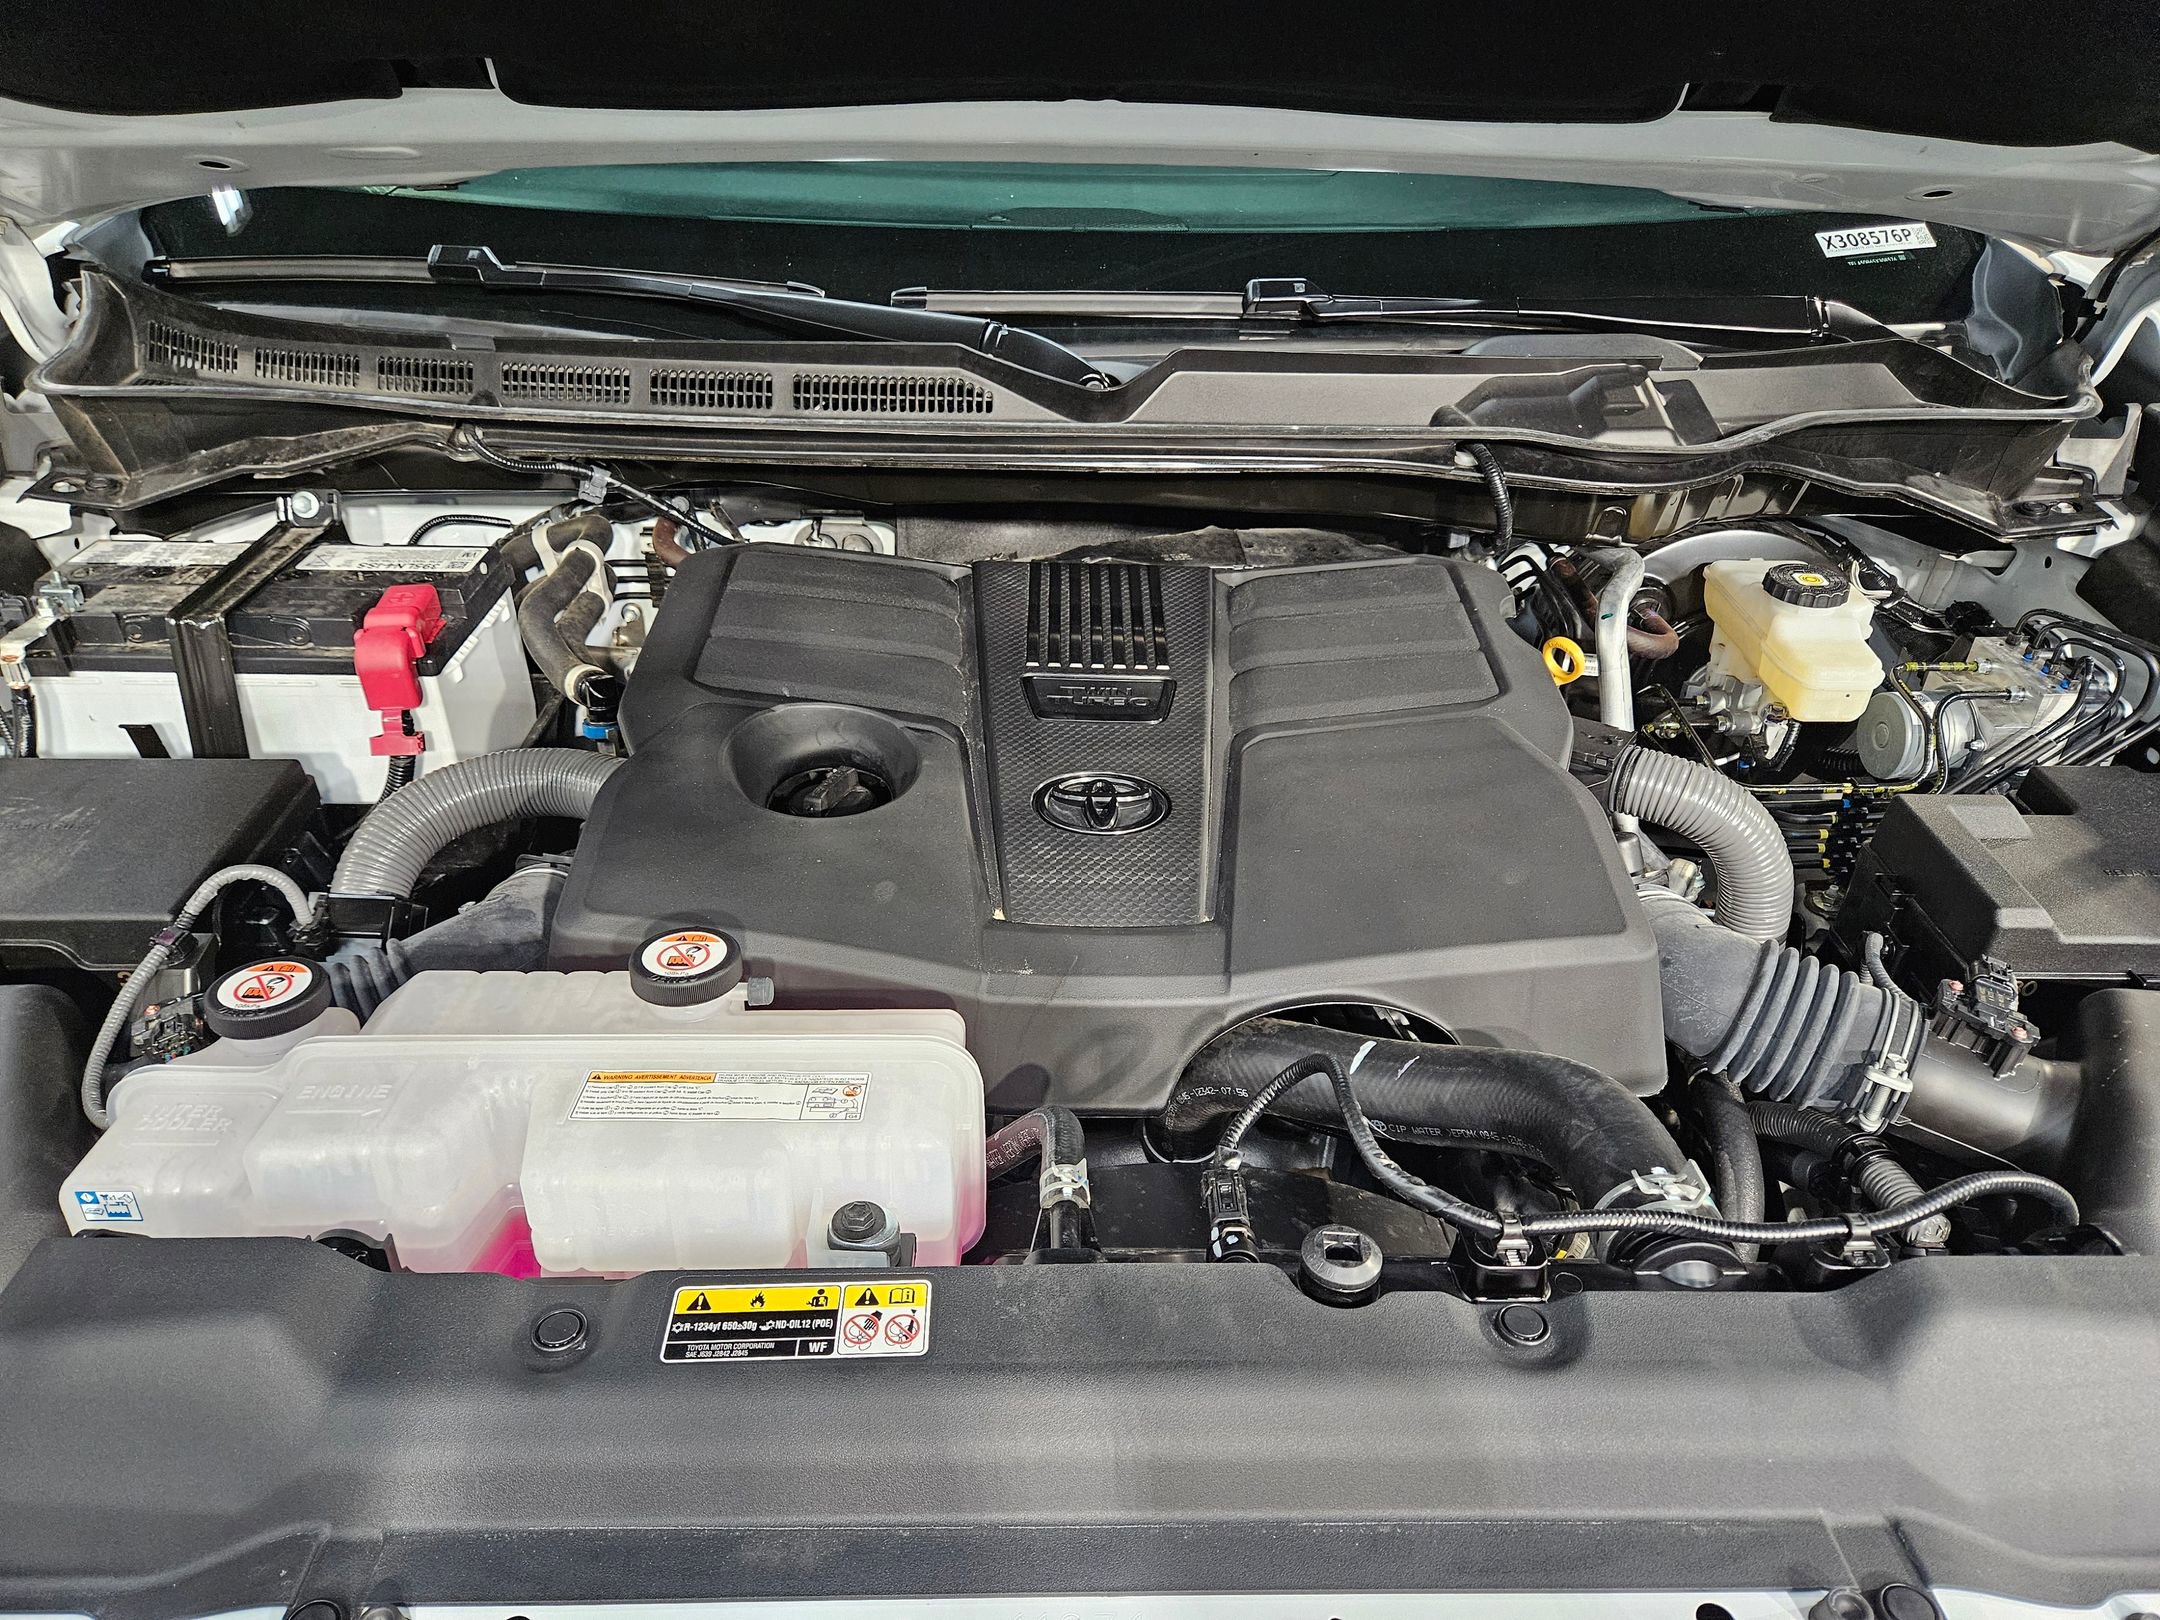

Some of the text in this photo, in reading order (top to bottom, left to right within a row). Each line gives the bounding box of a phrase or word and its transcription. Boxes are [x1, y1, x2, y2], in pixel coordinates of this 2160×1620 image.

[1821, 228, 1912, 250] X308576P
[683, 1321, 722, 1333] R-1234yf
[775, 1319, 811, 1330] ND-OIL12
[812, 1318, 834, 1330] (POE)
[687, 1341, 775, 1351] TOYOTA MOTOR CORPORATION
[808, 1341, 828, 1353] WF
